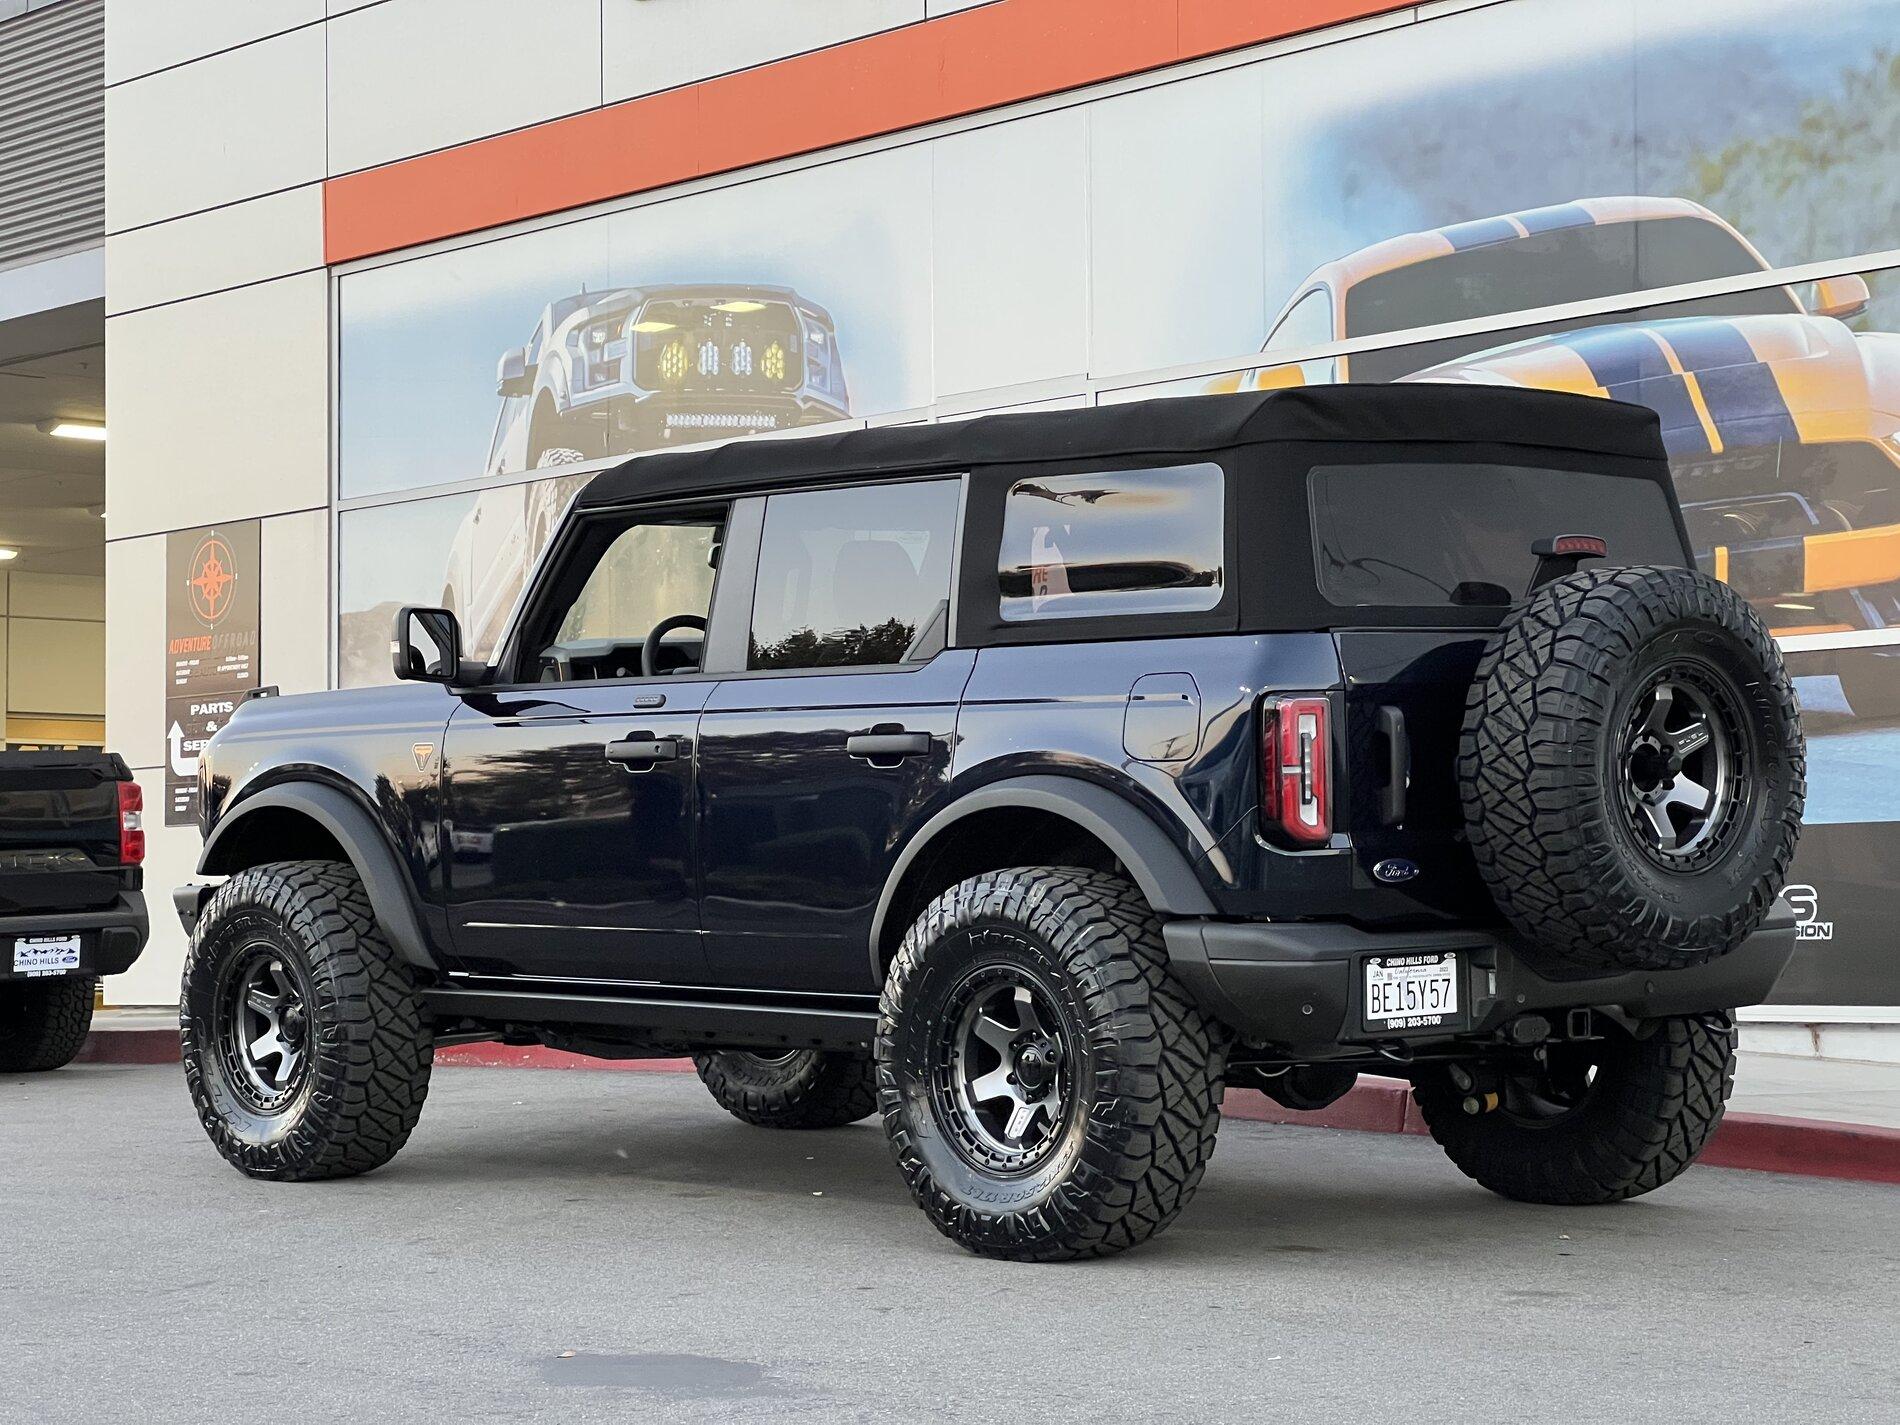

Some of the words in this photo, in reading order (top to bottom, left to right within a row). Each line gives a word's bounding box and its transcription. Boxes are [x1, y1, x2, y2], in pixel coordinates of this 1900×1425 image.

[169, 635, 212, 654] ADVENTURE
[213, 631, 256, 650] OFFROAD
[190, 701, 234, 716] PARTS
[205, 720, 218, 732] &
[1384, 864, 1410, 877] Ford
[14, 958, 38, 967] CHINO
[39, 957, 59, 965] HILLS
[1386, 957, 1405, 967] CHINO
[1406, 956, 1422, 965] HILLS
[1423, 955, 1439, 965] FORD
[1372, 970, 1384, 978] JAN
[1395, 967, 1427, 977] California
[1371, 978, 1451, 1014] BE15Y57
[1387, 1018, 1406, 1030] (909)
[1407, 1015, 1442, 1028] 203-5700
